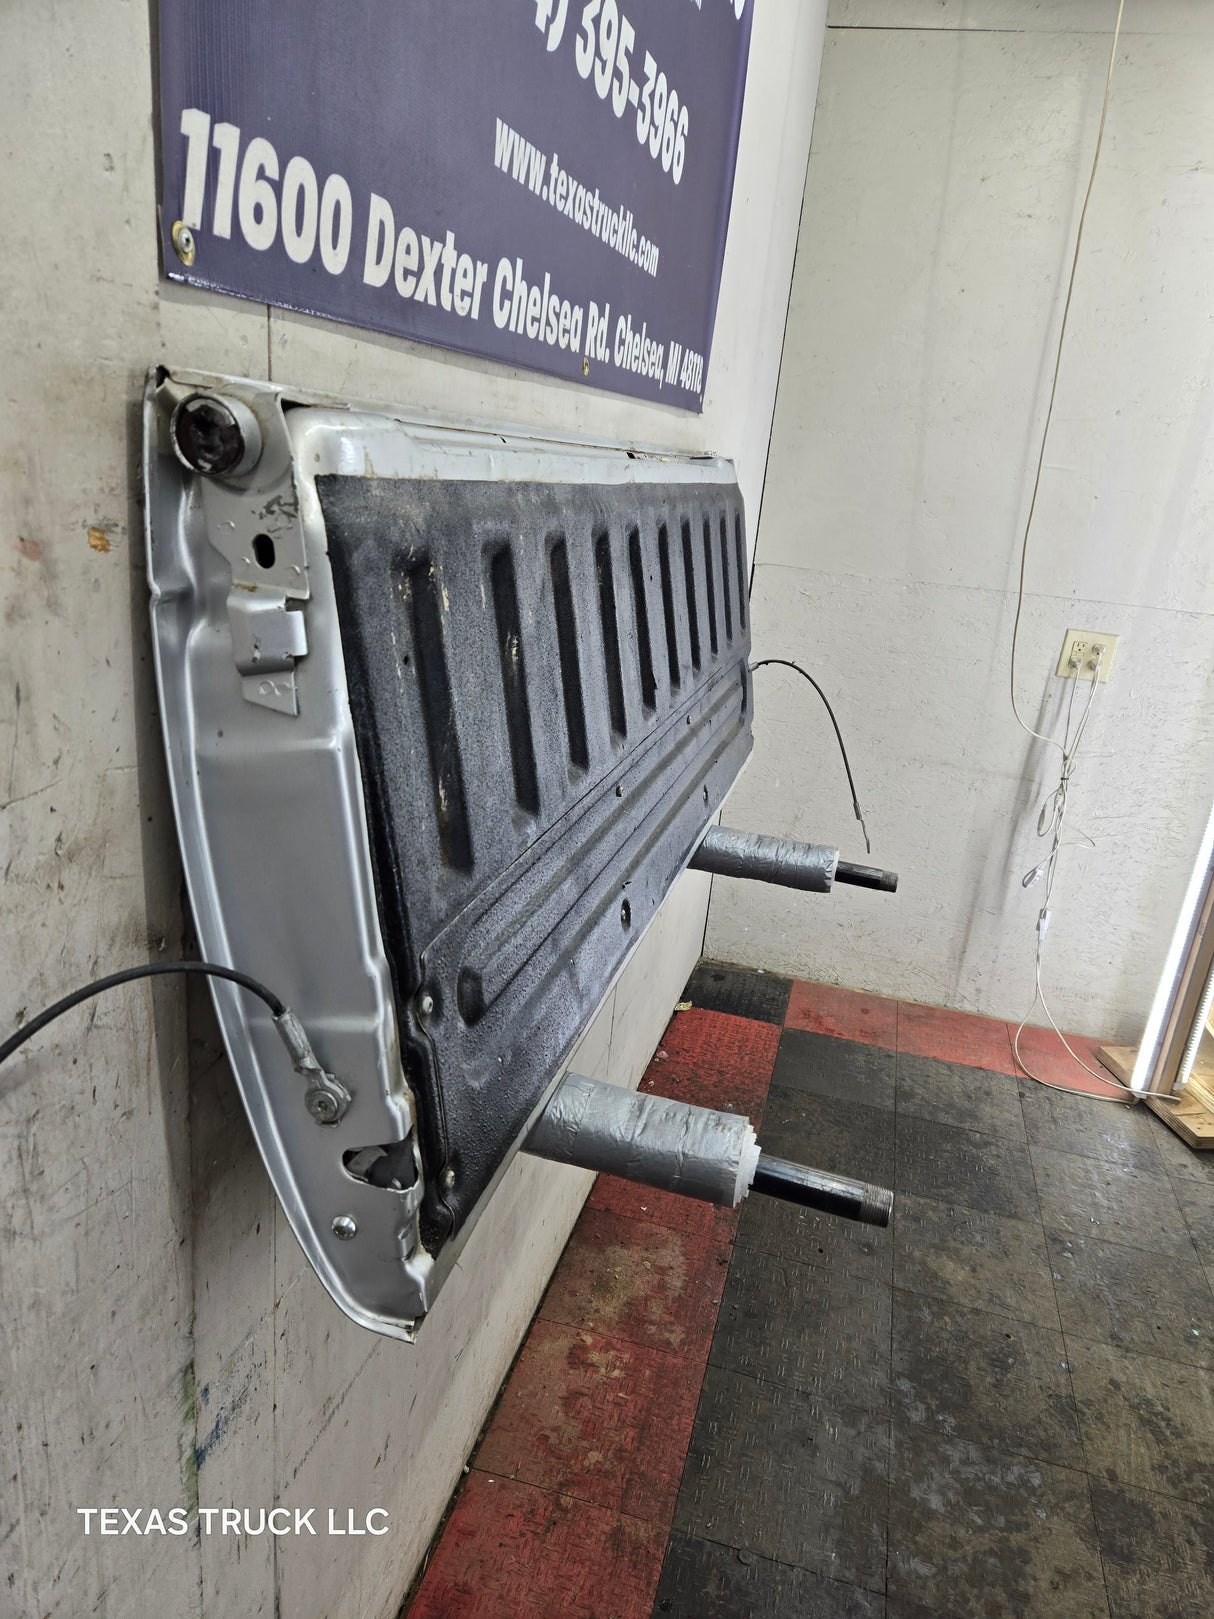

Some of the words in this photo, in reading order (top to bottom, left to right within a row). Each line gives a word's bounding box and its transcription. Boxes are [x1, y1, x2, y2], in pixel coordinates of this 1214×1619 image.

[575, 0, 689, 185] 395-3966
[180, 108, 353, 276] 11600
[363, 193, 488, 320] Dexter
[493, 257, 584, 354] Chelsea
[584, 300, 610, 364] Rd.
[614, 314, 664, 390] Chelsea,
[665, 340, 682, 386] MI
[494, 117, 660, 277] www.texastruckllc.com
